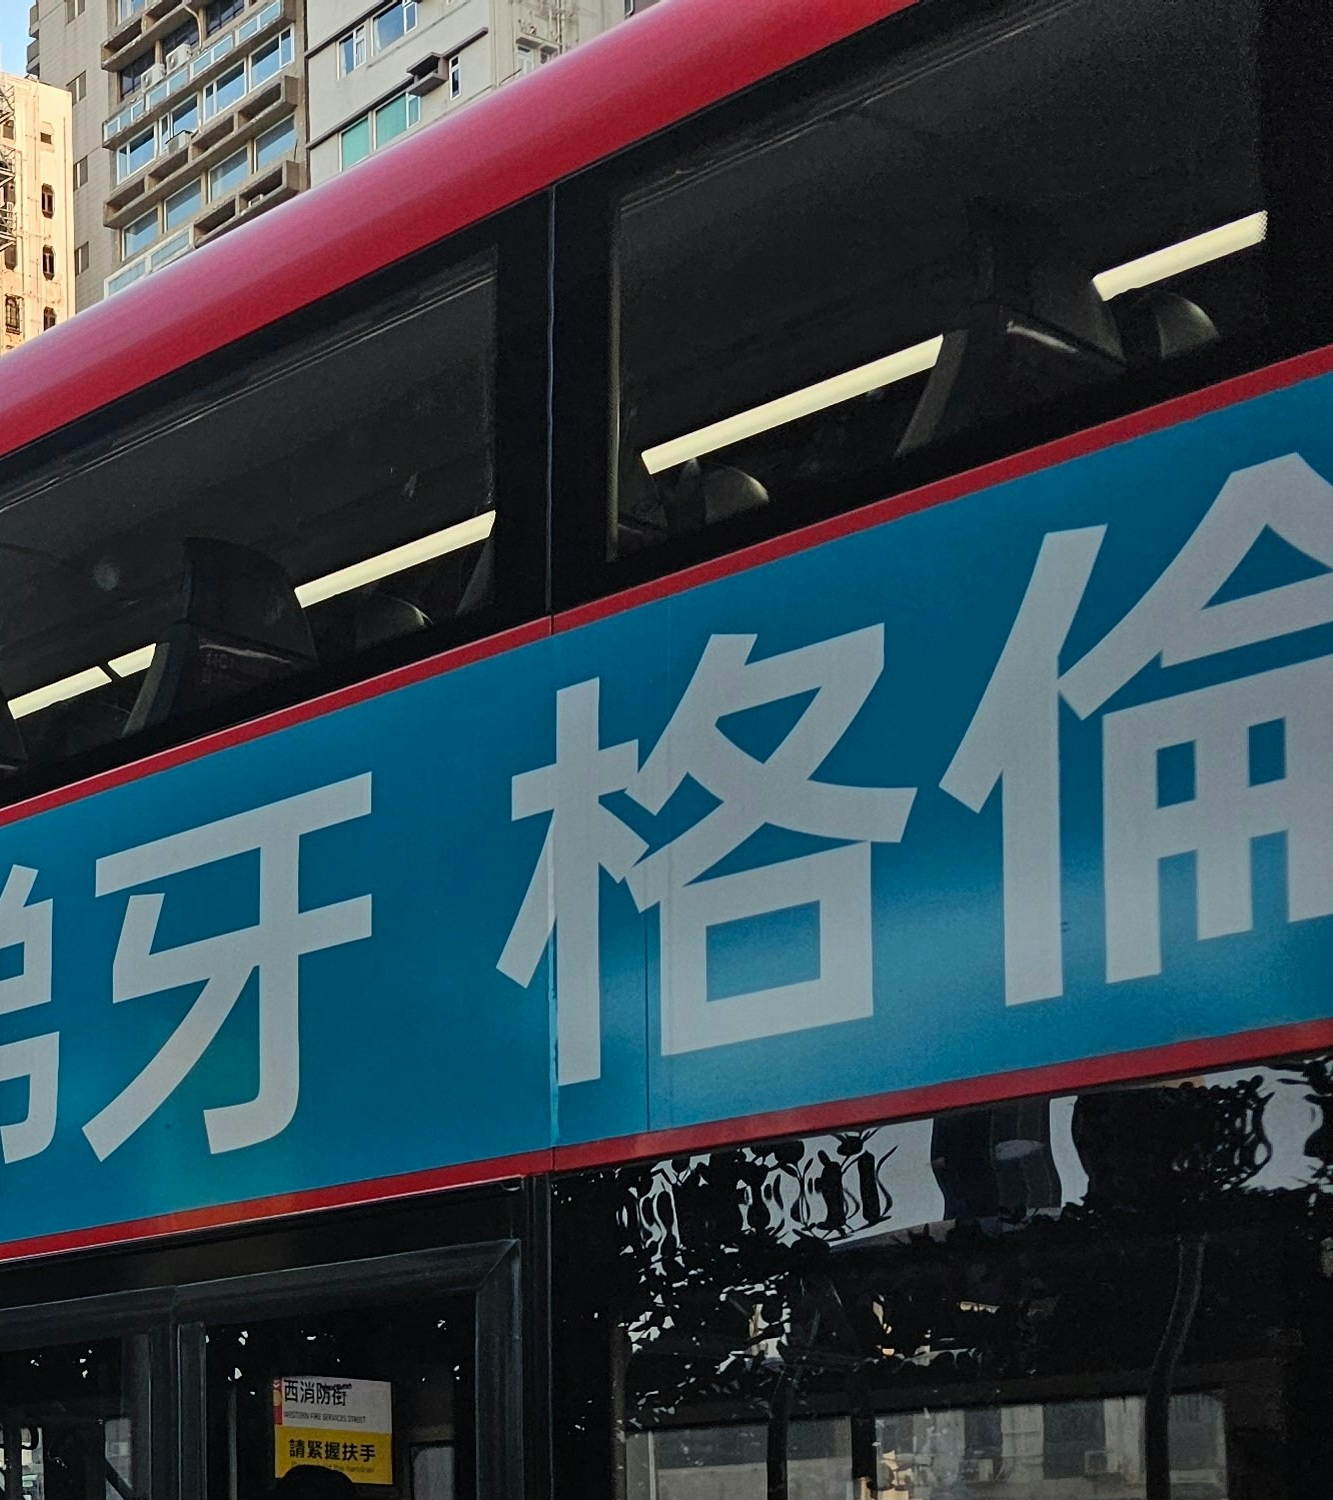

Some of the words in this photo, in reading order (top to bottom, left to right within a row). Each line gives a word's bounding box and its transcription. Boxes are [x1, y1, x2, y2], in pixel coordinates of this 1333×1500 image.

[499, 452, 1333, 1087] 格倫
[284, 1380, 347, 1406] 西消防街
[289, 1438, 376, 1463] 請緊握扶手
